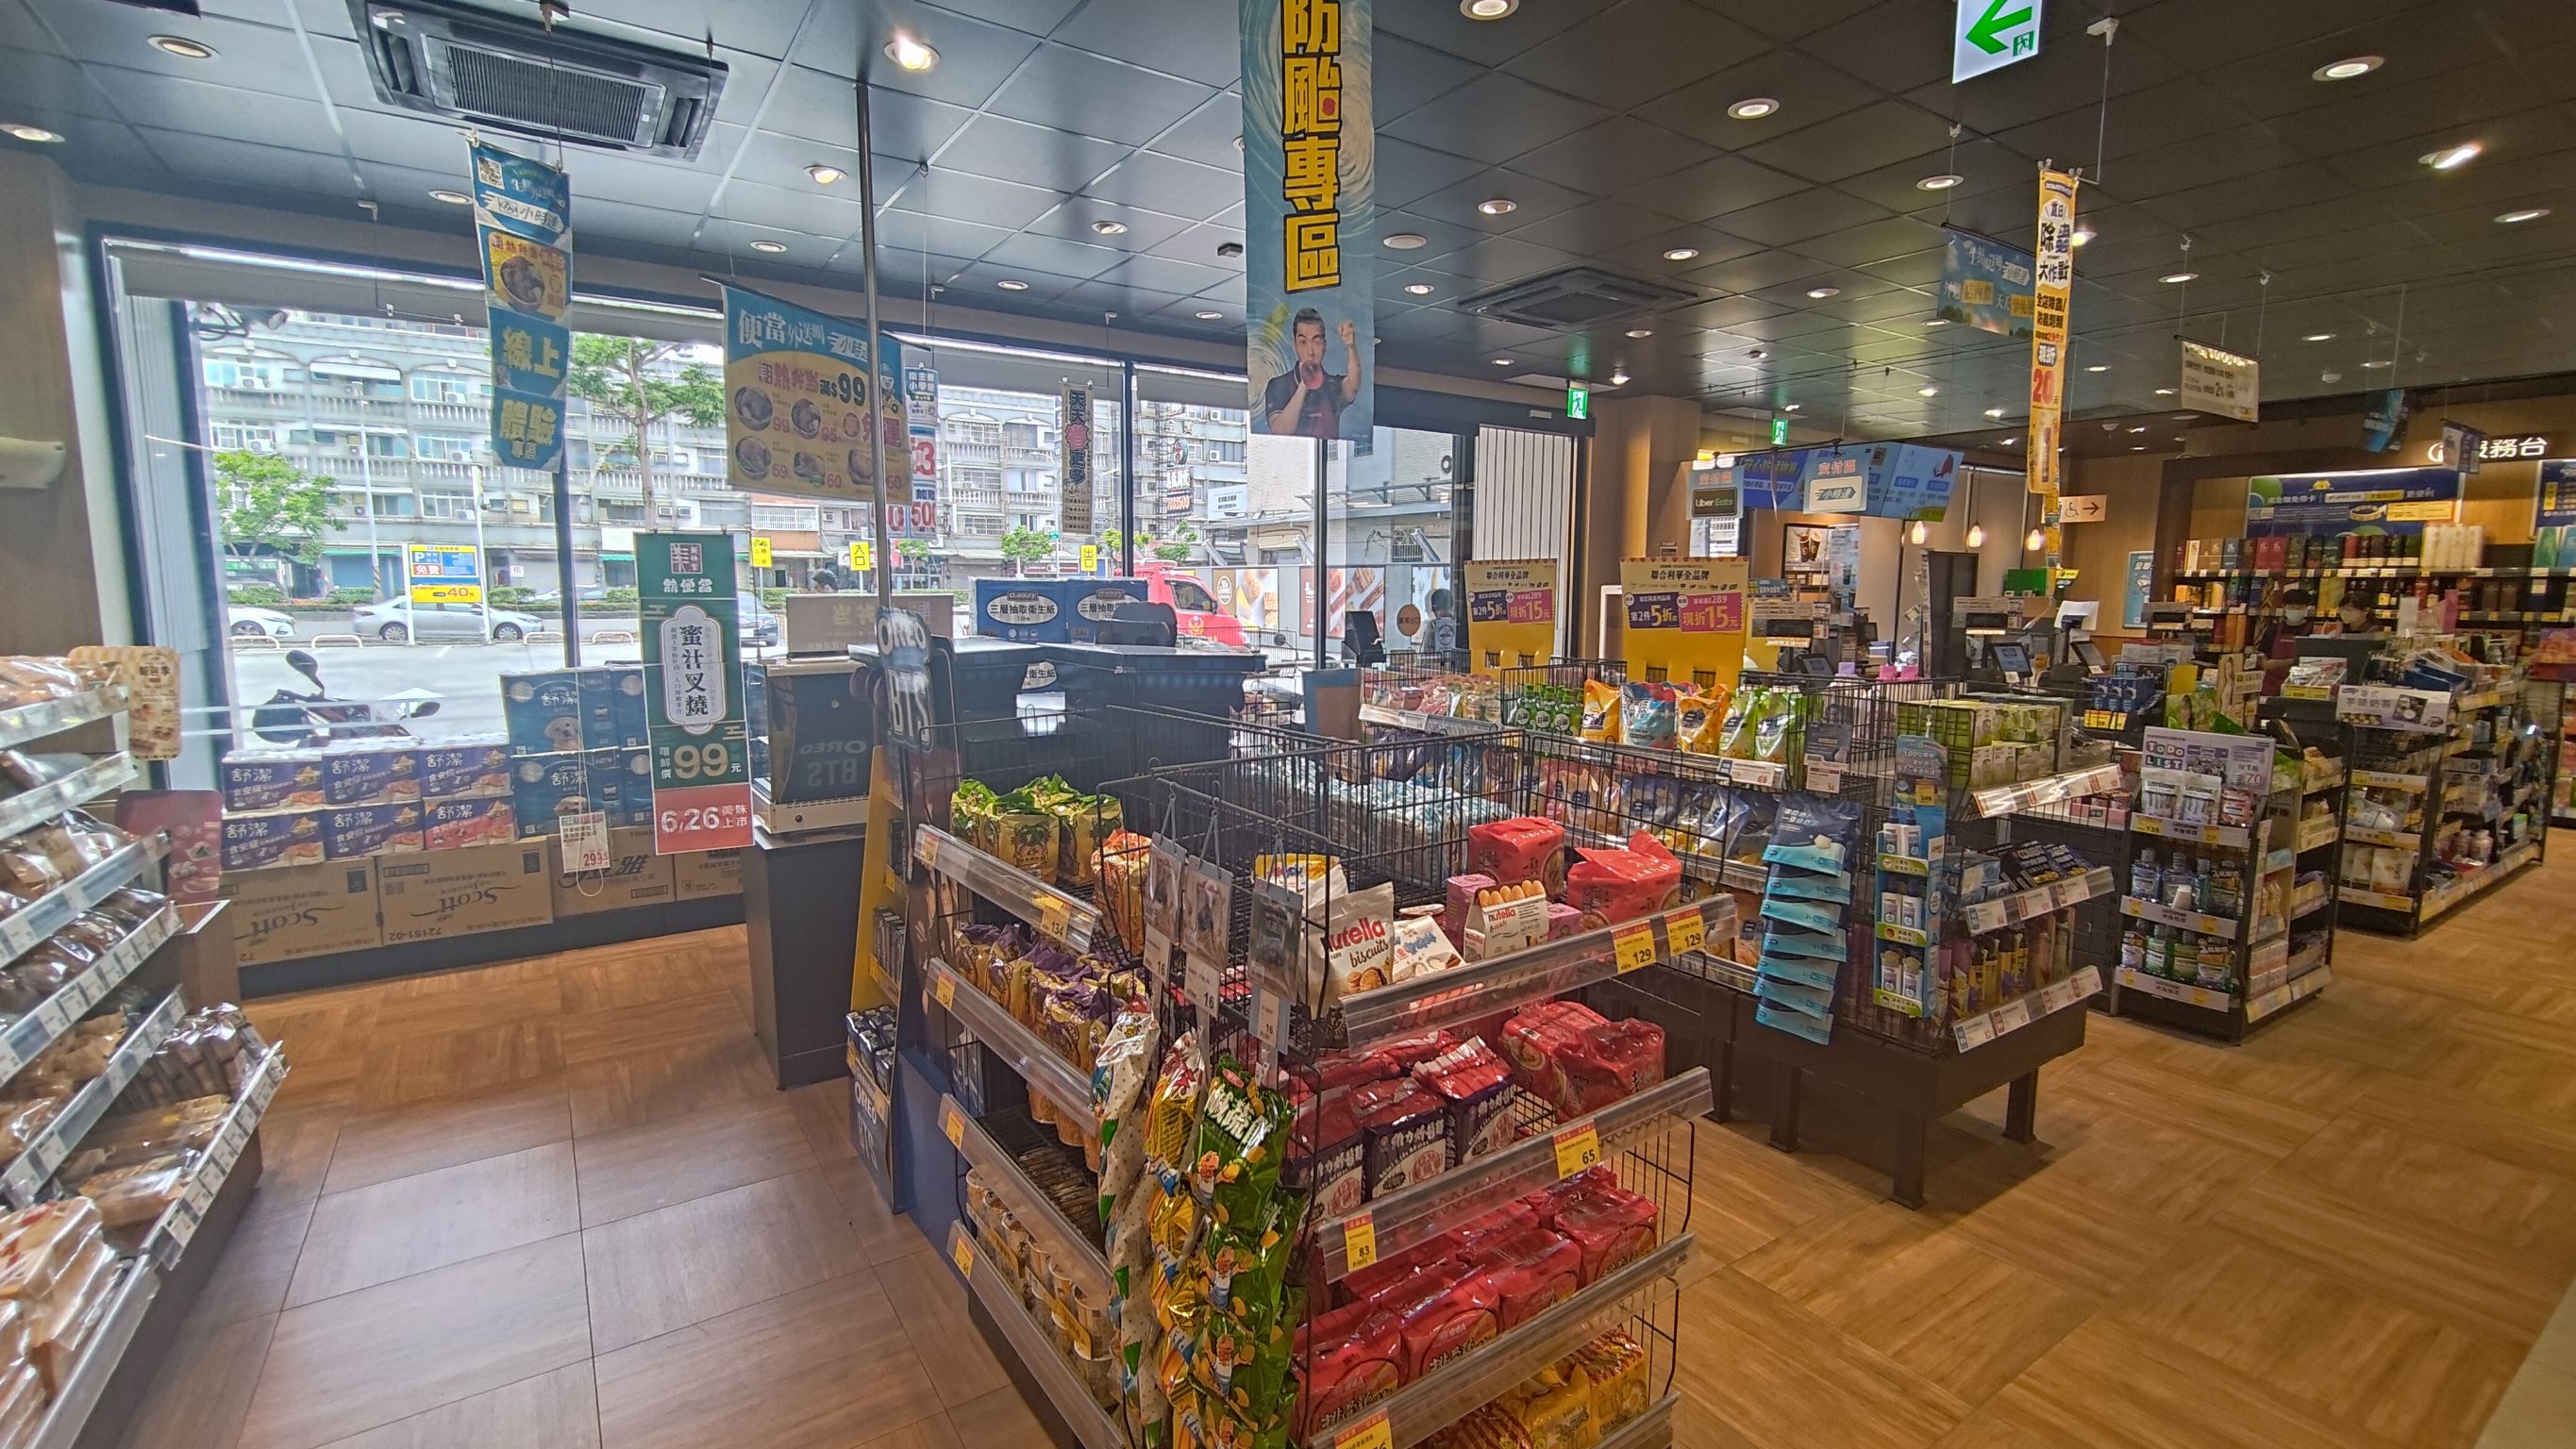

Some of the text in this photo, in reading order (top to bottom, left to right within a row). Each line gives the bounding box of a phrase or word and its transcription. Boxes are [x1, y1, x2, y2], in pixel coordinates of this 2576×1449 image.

[503, 327, 560, 378] 線上
[2032, 368, 2054, 405] 20
[1696, 495, 1733, 507] Uber Eats
[1650, 569, 1710, 582] 聯合利華全品牌
[990, 604, 1056, 616] 三層抽取衛生紙
[679, 624, 710, 717] 蜜汁叉燒
[887, 667, 932, 745] BTS
[330, 759, 372, 776] 舒潔
[426, 753, 464, 770] 舒潔
[674, 742, 728, 781] 99
[231, 767, 274, 785] 舒潔
[333, 810, 375, 828] 舒潔
[437, 803, 474, 821] 舒潔
[661, 807, 720, 835] 6/26
[226, 822, 270, 840] 舒潔
[721, 818, 748, 830] 上市
[1488, 907, 1516, 923] nutella
[1050, 921, 1065, 937] 134
[1684, 932, 1702, 949] 129
[1349, 938, 1389, 969] biscuits
[1632, 946, 1652, 965] 129
[1157, 959, 1166, 976] 16
[1203, 991, 1215, 1010] 16
[1265, 1023, 1274, 1035] 16
[1581, 1148, 1597, 1166] 65
[1358, 1243, 1371, 1257] 83
